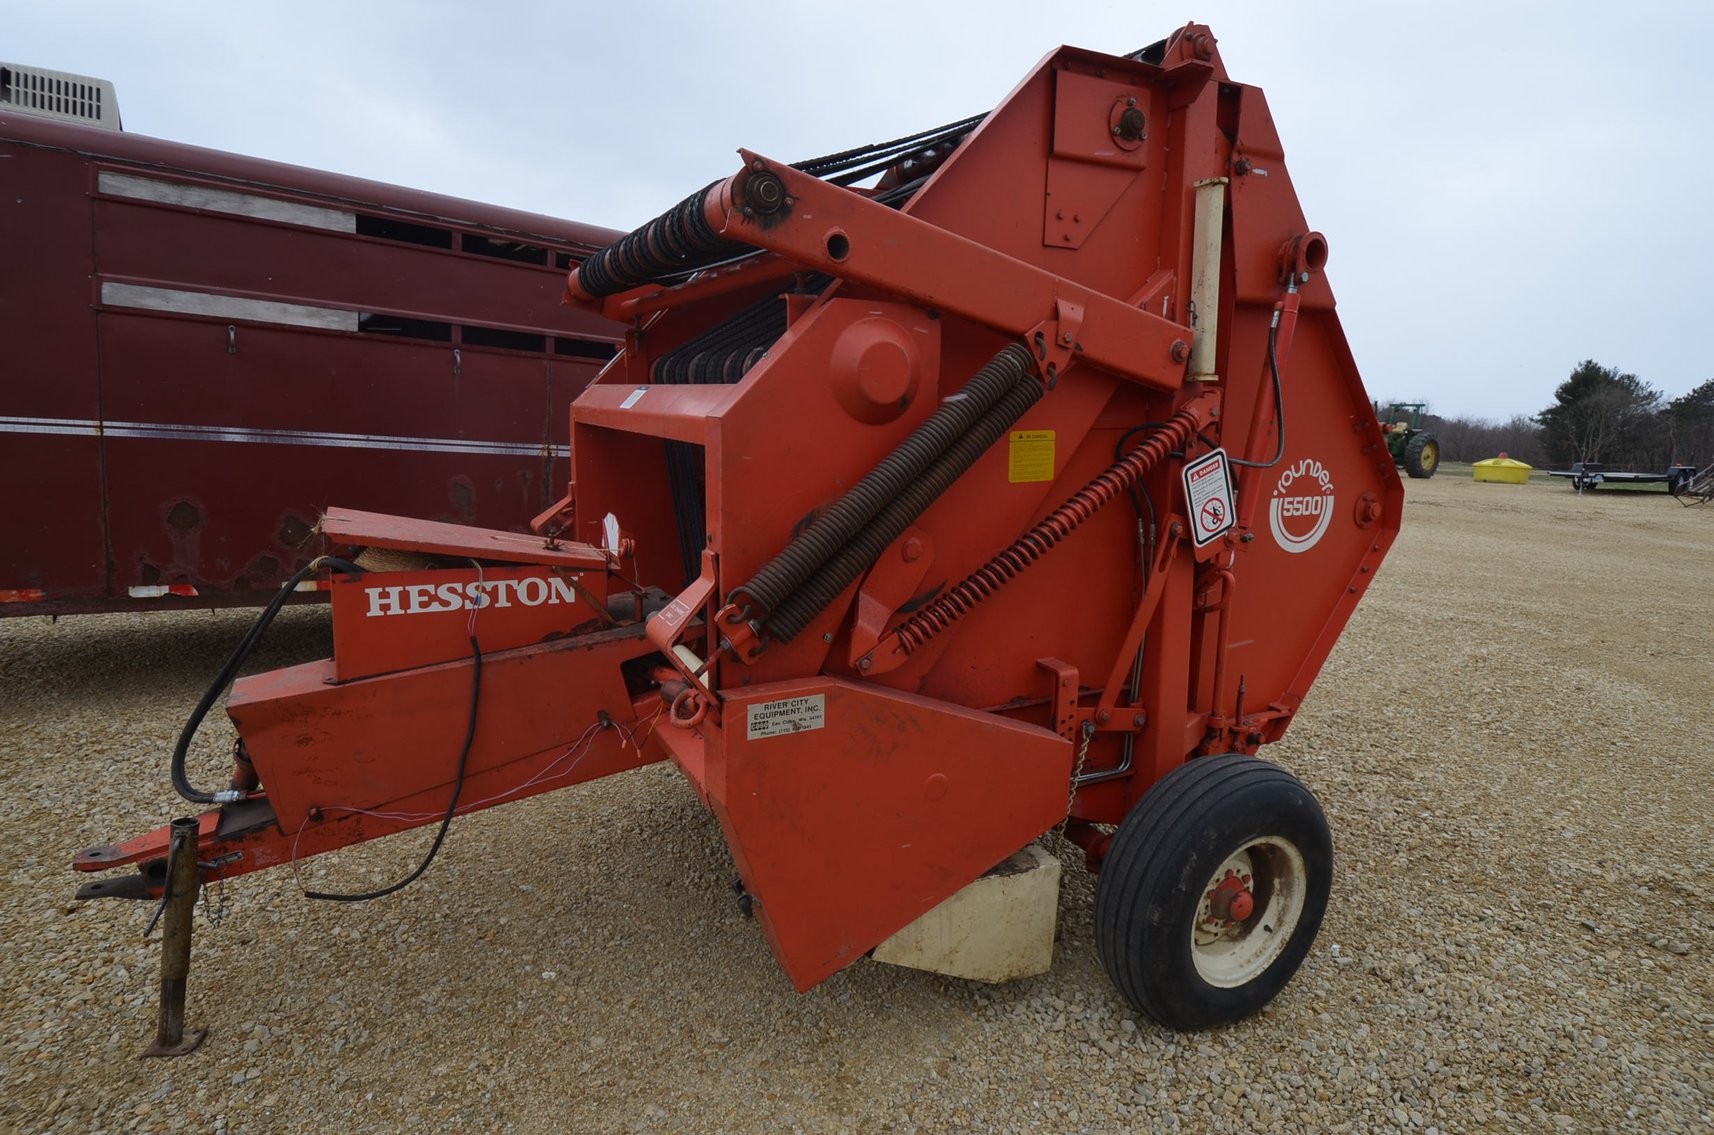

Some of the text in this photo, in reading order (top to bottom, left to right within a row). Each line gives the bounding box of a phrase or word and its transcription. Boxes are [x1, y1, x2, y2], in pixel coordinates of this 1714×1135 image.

[1199, 461, 1219, 476] DANGER
[1283, 496, 1322, 517] 5500
[364, 575, 578, 617] HESSTON
[754, 704, 821, 721] EQUIPMENT, INC.
[764, 698, 809, 711] RIVER CITY
